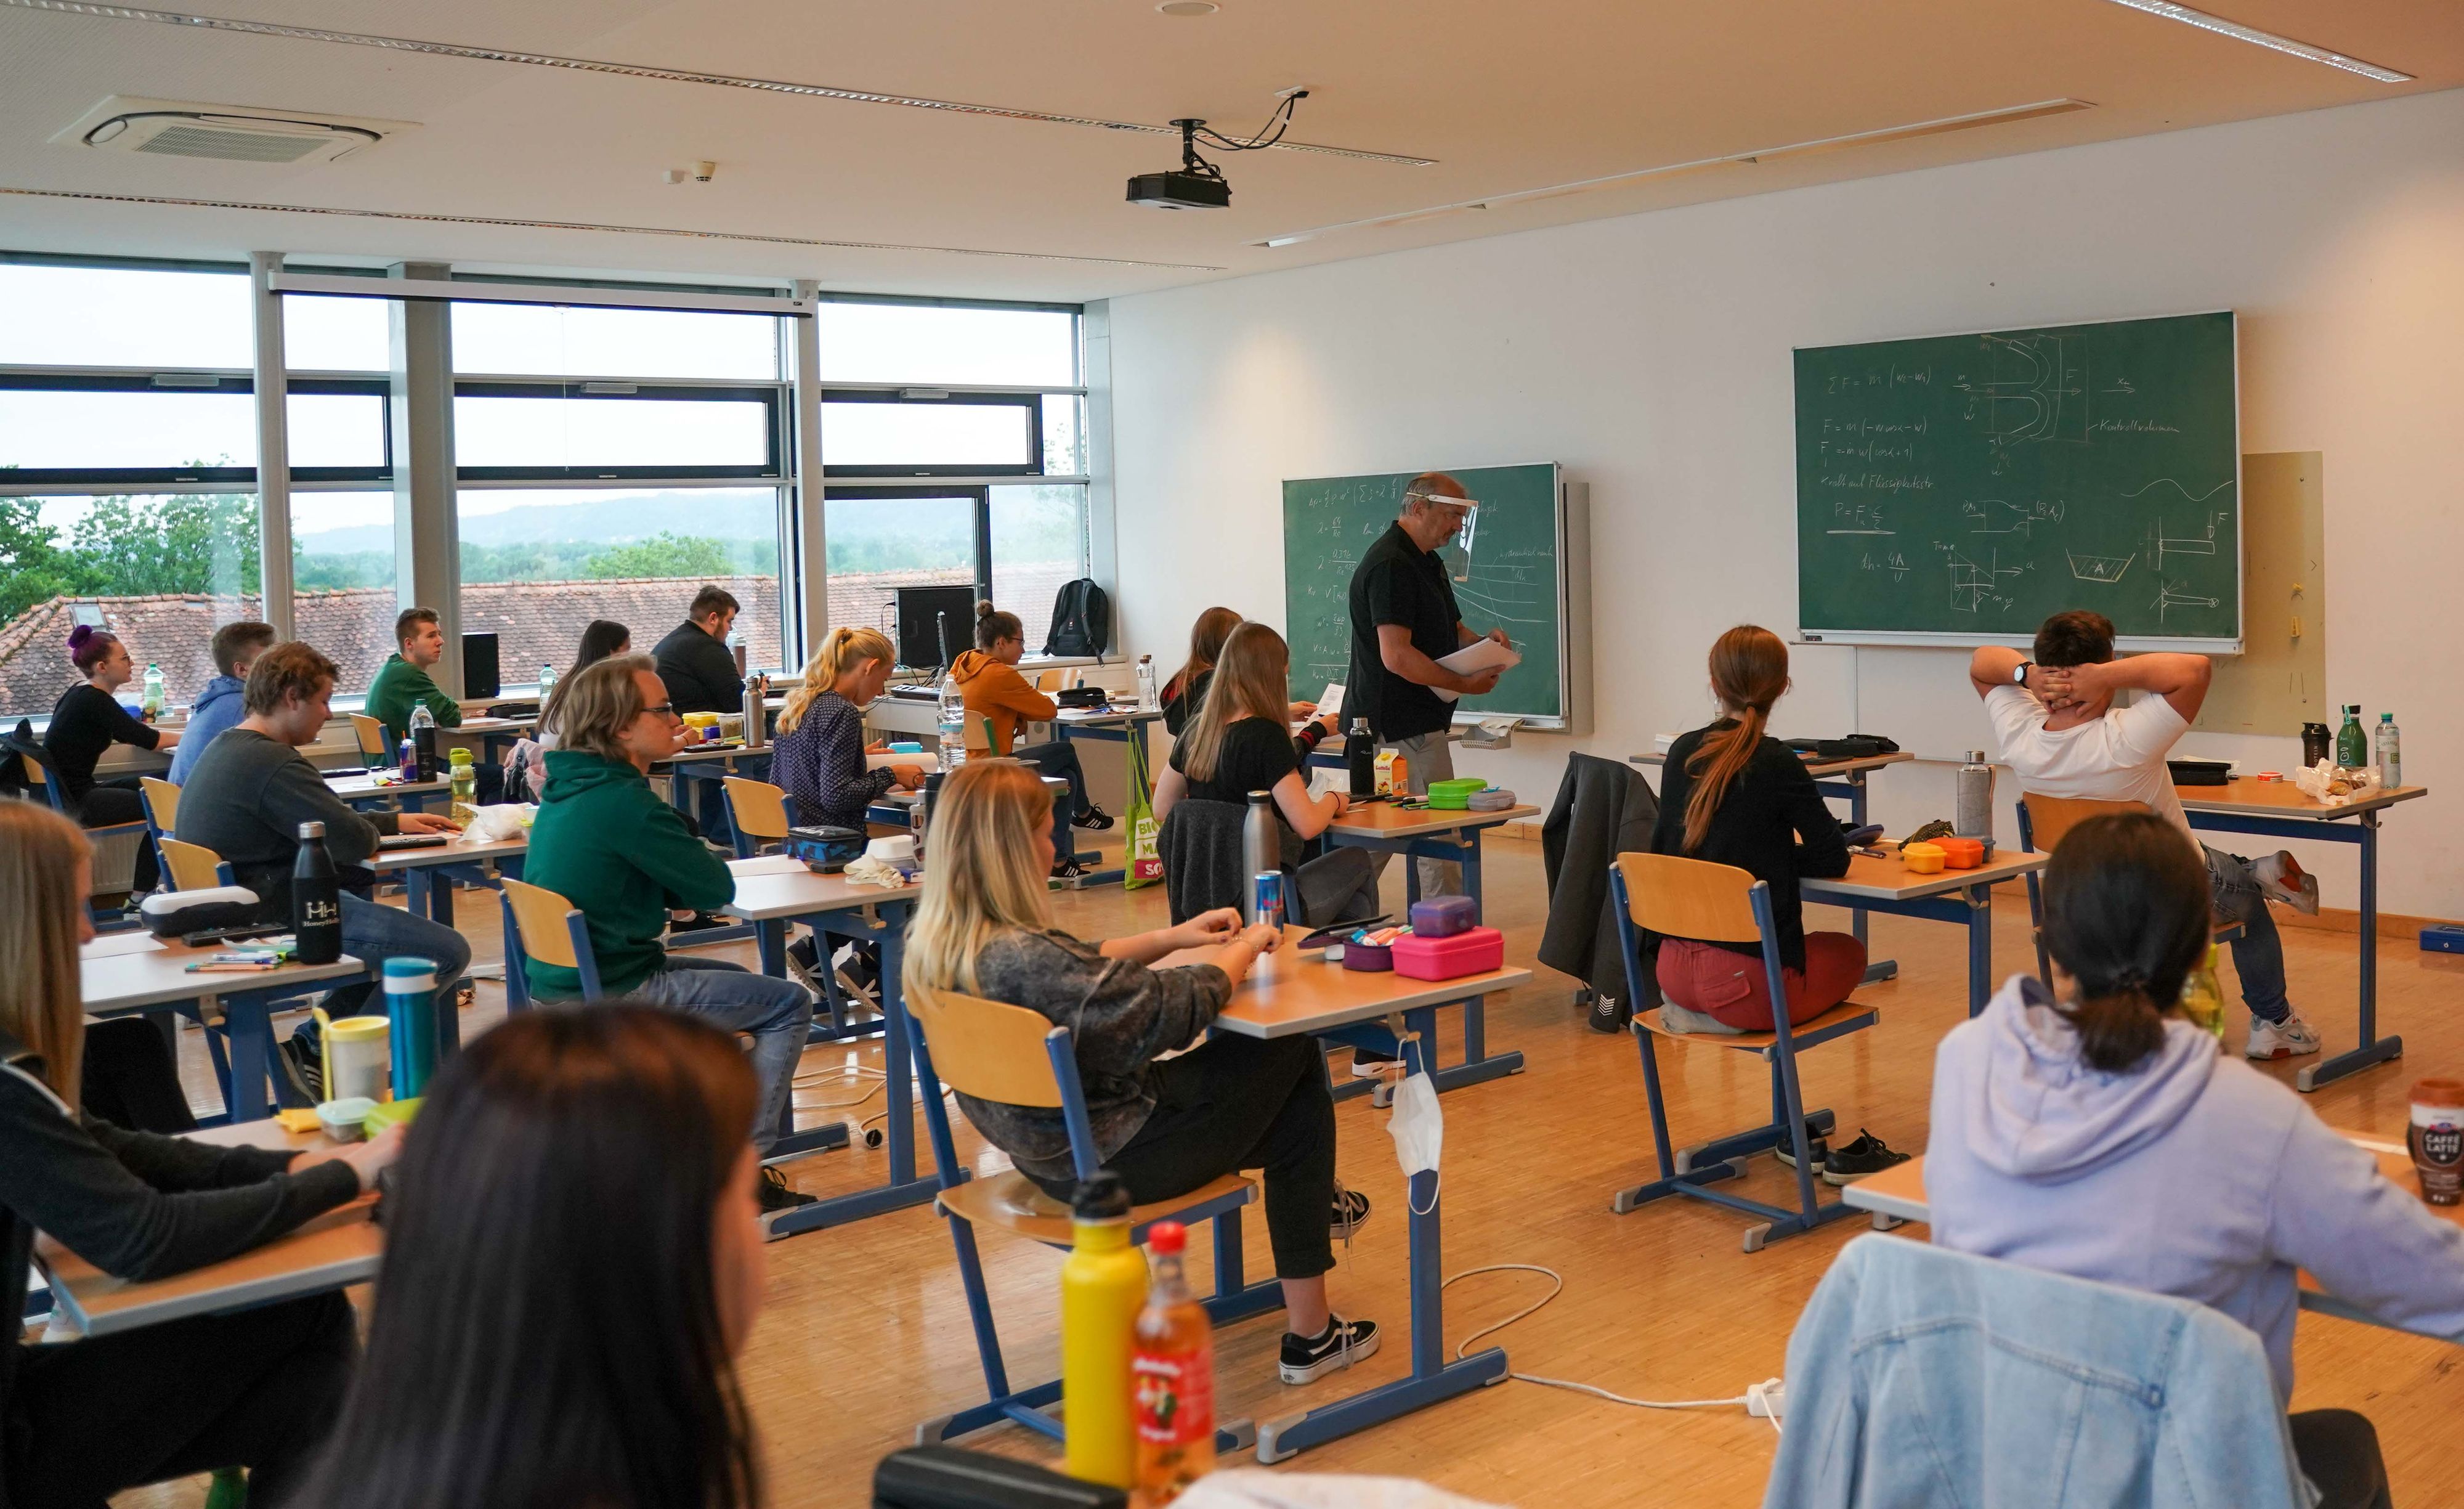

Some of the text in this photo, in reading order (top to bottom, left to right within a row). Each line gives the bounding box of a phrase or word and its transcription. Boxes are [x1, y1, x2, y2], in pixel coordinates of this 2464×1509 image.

[2066, 369, 2078, 382] F
[2094, 563, 2104, 576] A
[2426, 1143, 2459, 1153] LATTE
